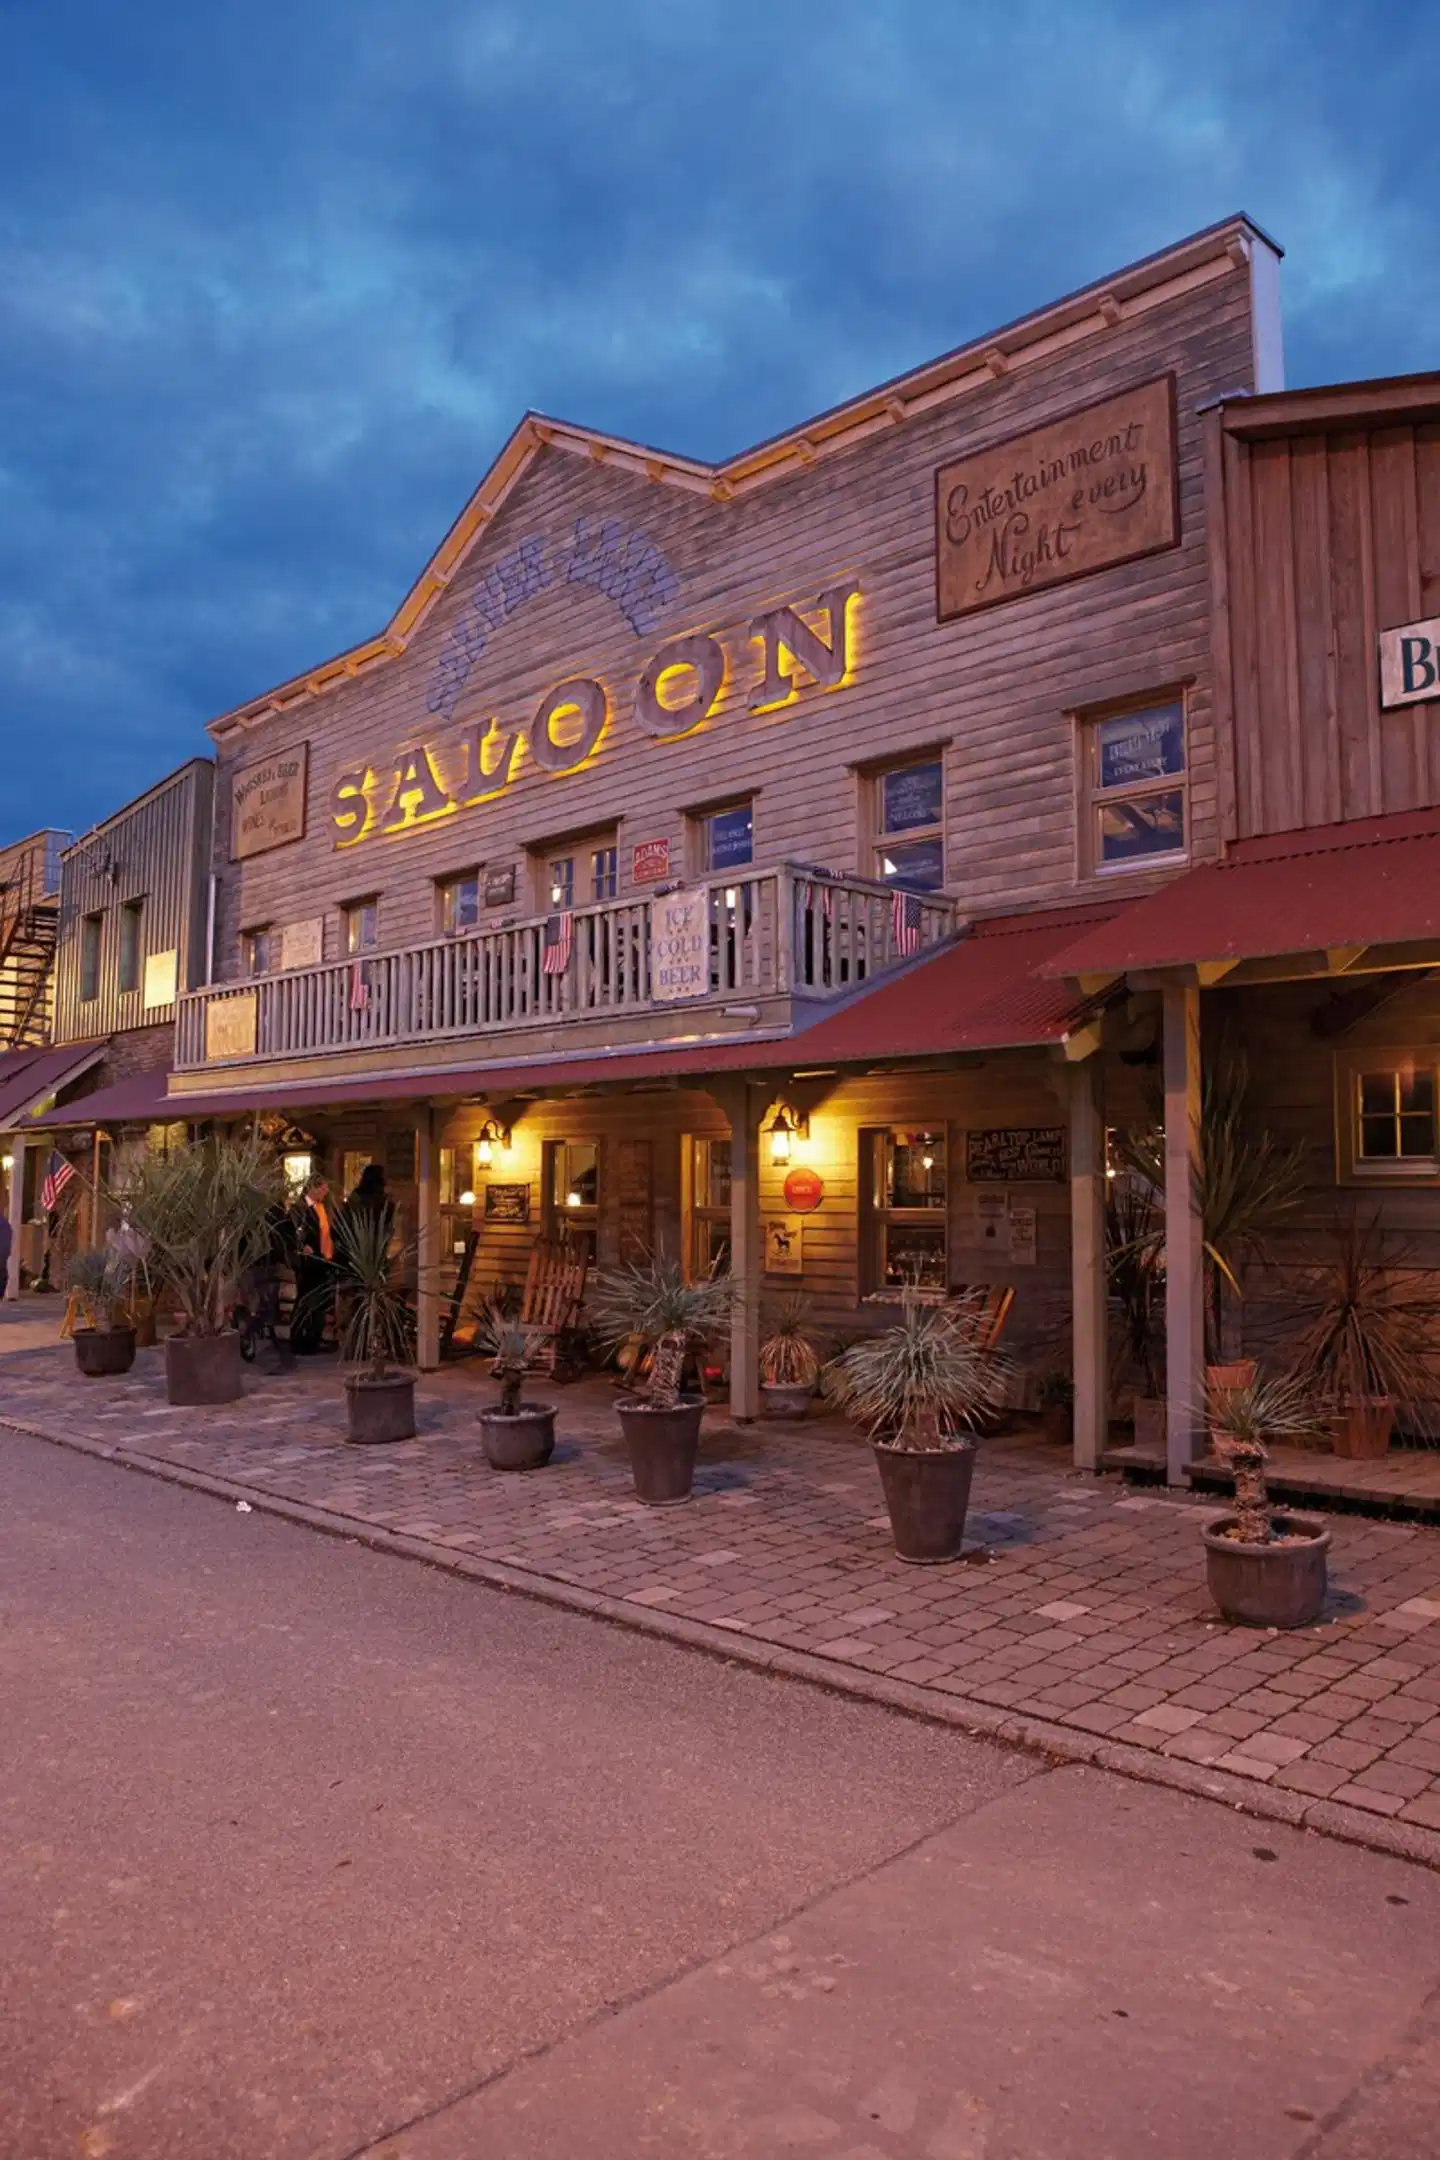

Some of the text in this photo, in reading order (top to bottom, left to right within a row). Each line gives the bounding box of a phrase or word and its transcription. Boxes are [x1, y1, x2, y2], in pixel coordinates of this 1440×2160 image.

[945, 421, 1145, 546] Entertainment
[1071, 462, 1148, 515] every
[975, 511, 1081, 592] Night
[1401, 635, 1440, 694] B
[332, 577, 861, 852] SALOON
[665, 902, 694, 931] ICE
[657, 934, 702, 960] COLD
[659, 964, 702, 987] BEER
